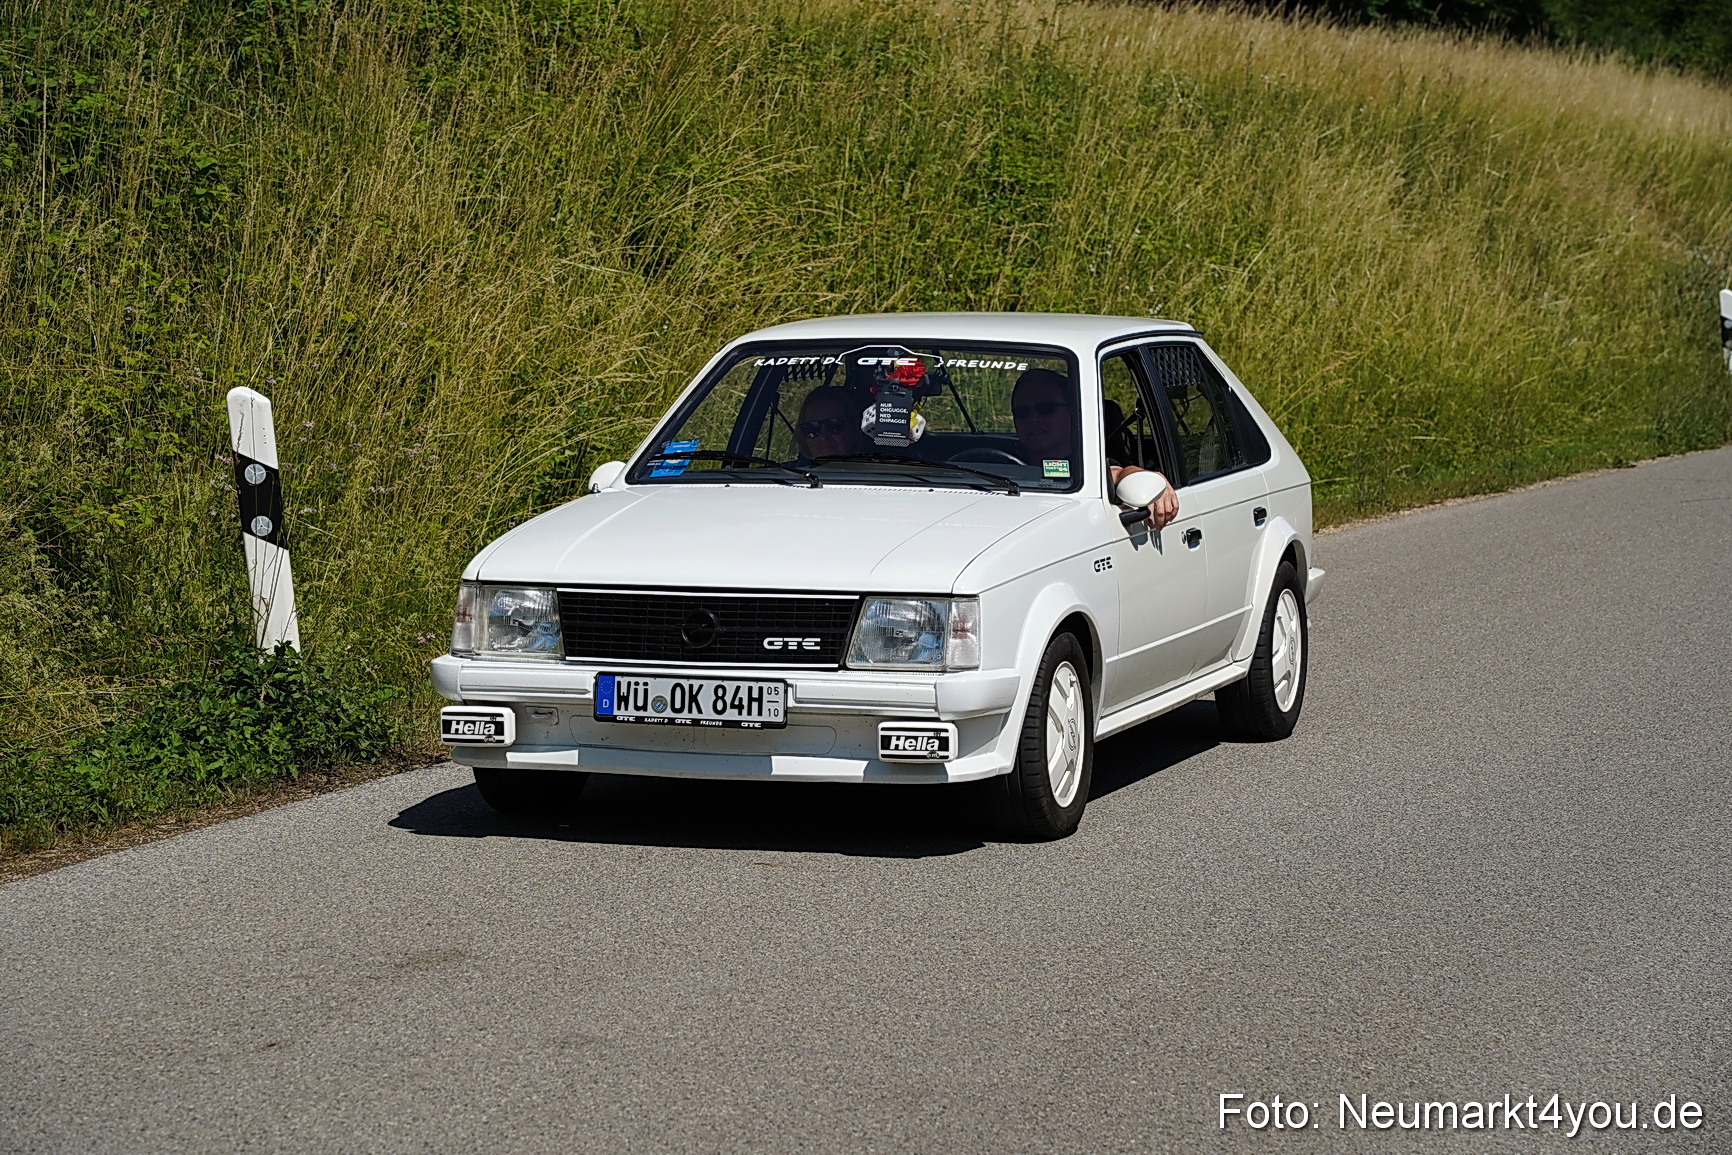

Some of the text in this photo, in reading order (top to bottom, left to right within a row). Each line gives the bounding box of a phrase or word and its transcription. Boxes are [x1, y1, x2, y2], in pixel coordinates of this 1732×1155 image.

[753, 357, 1028, 371] KADETT D GTE FREUNDE
[1094, 556, 1112, 572] GTE
[763, 637, 821, 650] GTE
[766, 686, 779, 696] 05
[602, 699, 610, 708] D
[616, 680, 764, 717] WÜ OK 84H
[767, 708, 779, 717] 10
[450, 720, 496, 735] Hella
[890, 735, 939, 751] Hella
